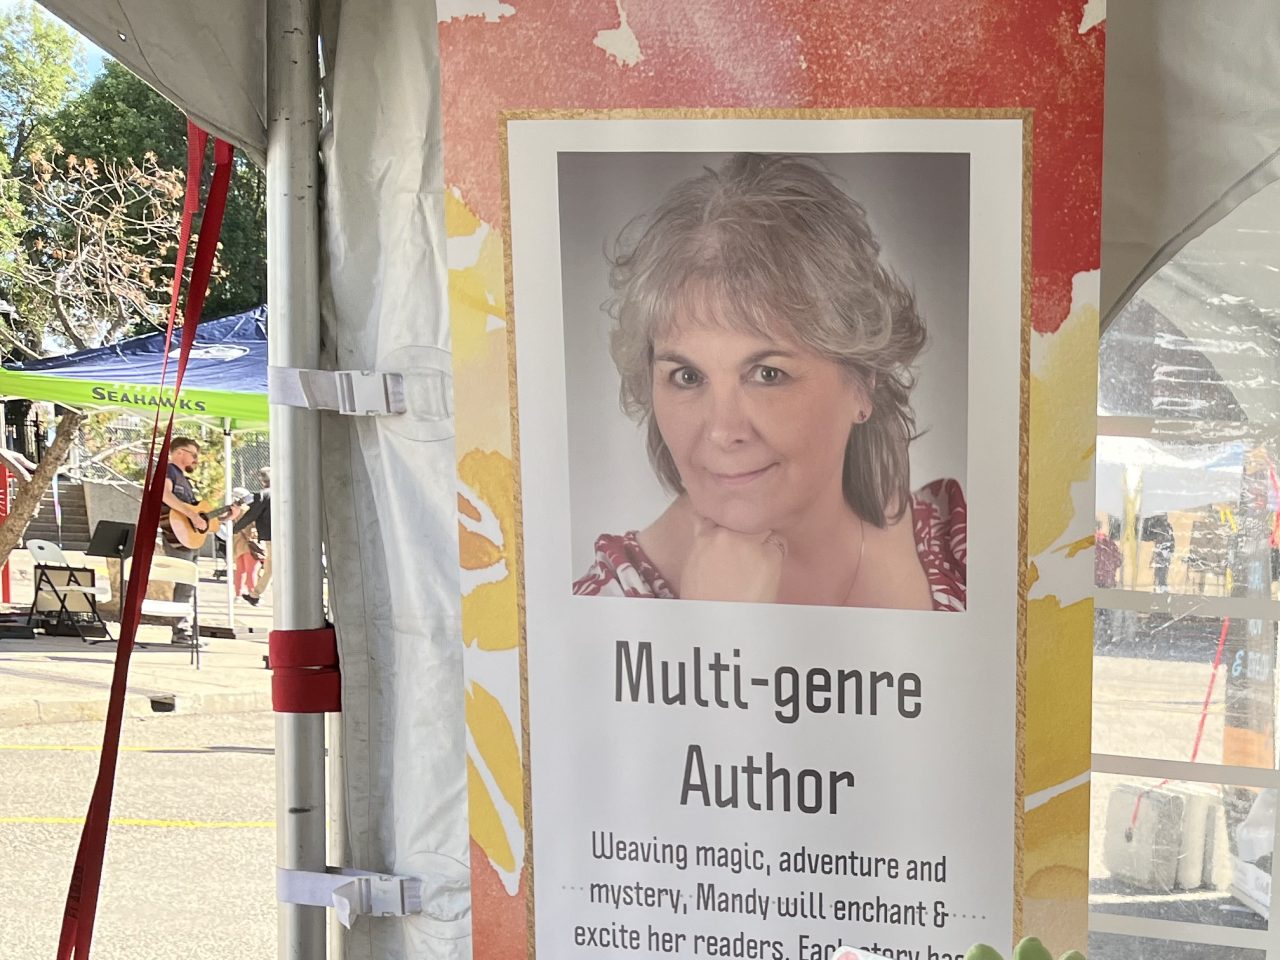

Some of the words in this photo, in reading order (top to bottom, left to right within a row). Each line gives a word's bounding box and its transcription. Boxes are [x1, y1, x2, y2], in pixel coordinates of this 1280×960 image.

[92, 386, 206, 412] SEAHAWKS
[613, 640, 923, 724] Multi-genre
[680, 743, 855, 815] Author
[591, 830, 688, 870] Weaving
[695, 842, 771, 876] magic,
[779, 846, 900, 879] adventure
[906, 855, 947, 883] and
[590, 881, 688, 915] mystery,
[696, 882, 770, 920] Mandy
[777, 891, 826, 919] will
[833, 895, 926, 928] enchant
[933, 900, 949, 928] &
[574, 922, 641, 950] excite
[648, 924, 686, 953] her
